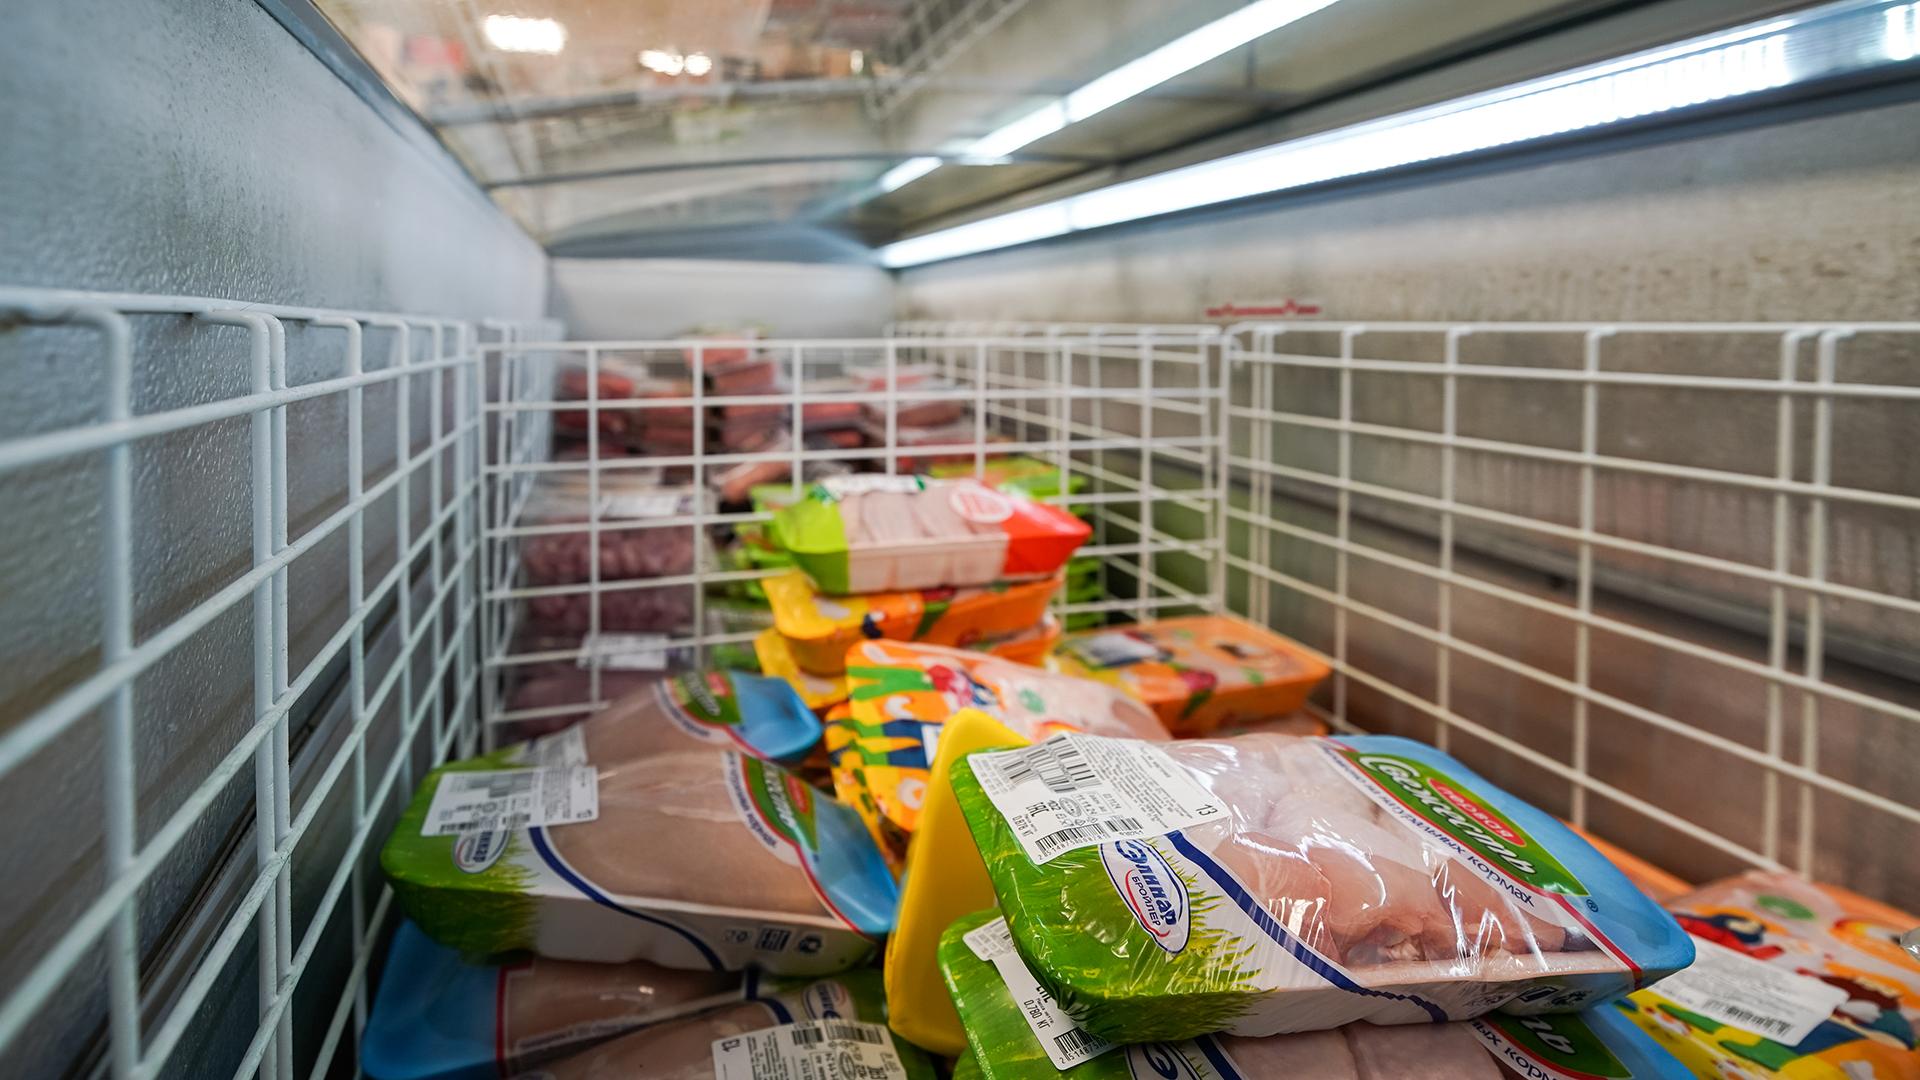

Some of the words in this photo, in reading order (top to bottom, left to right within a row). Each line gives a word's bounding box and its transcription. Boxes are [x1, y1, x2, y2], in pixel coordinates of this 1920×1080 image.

[1196, 804, 1218, 816] 13
[1358, 756, 1536, 874] Свежесть
[1437, 787, 1515, 839] первая
[1115, 840, 1177, 926] Элинар
[1131, 876, 1161, 926] БРОЙЛЕР
[1467, 855, 1535, 908] кормах
